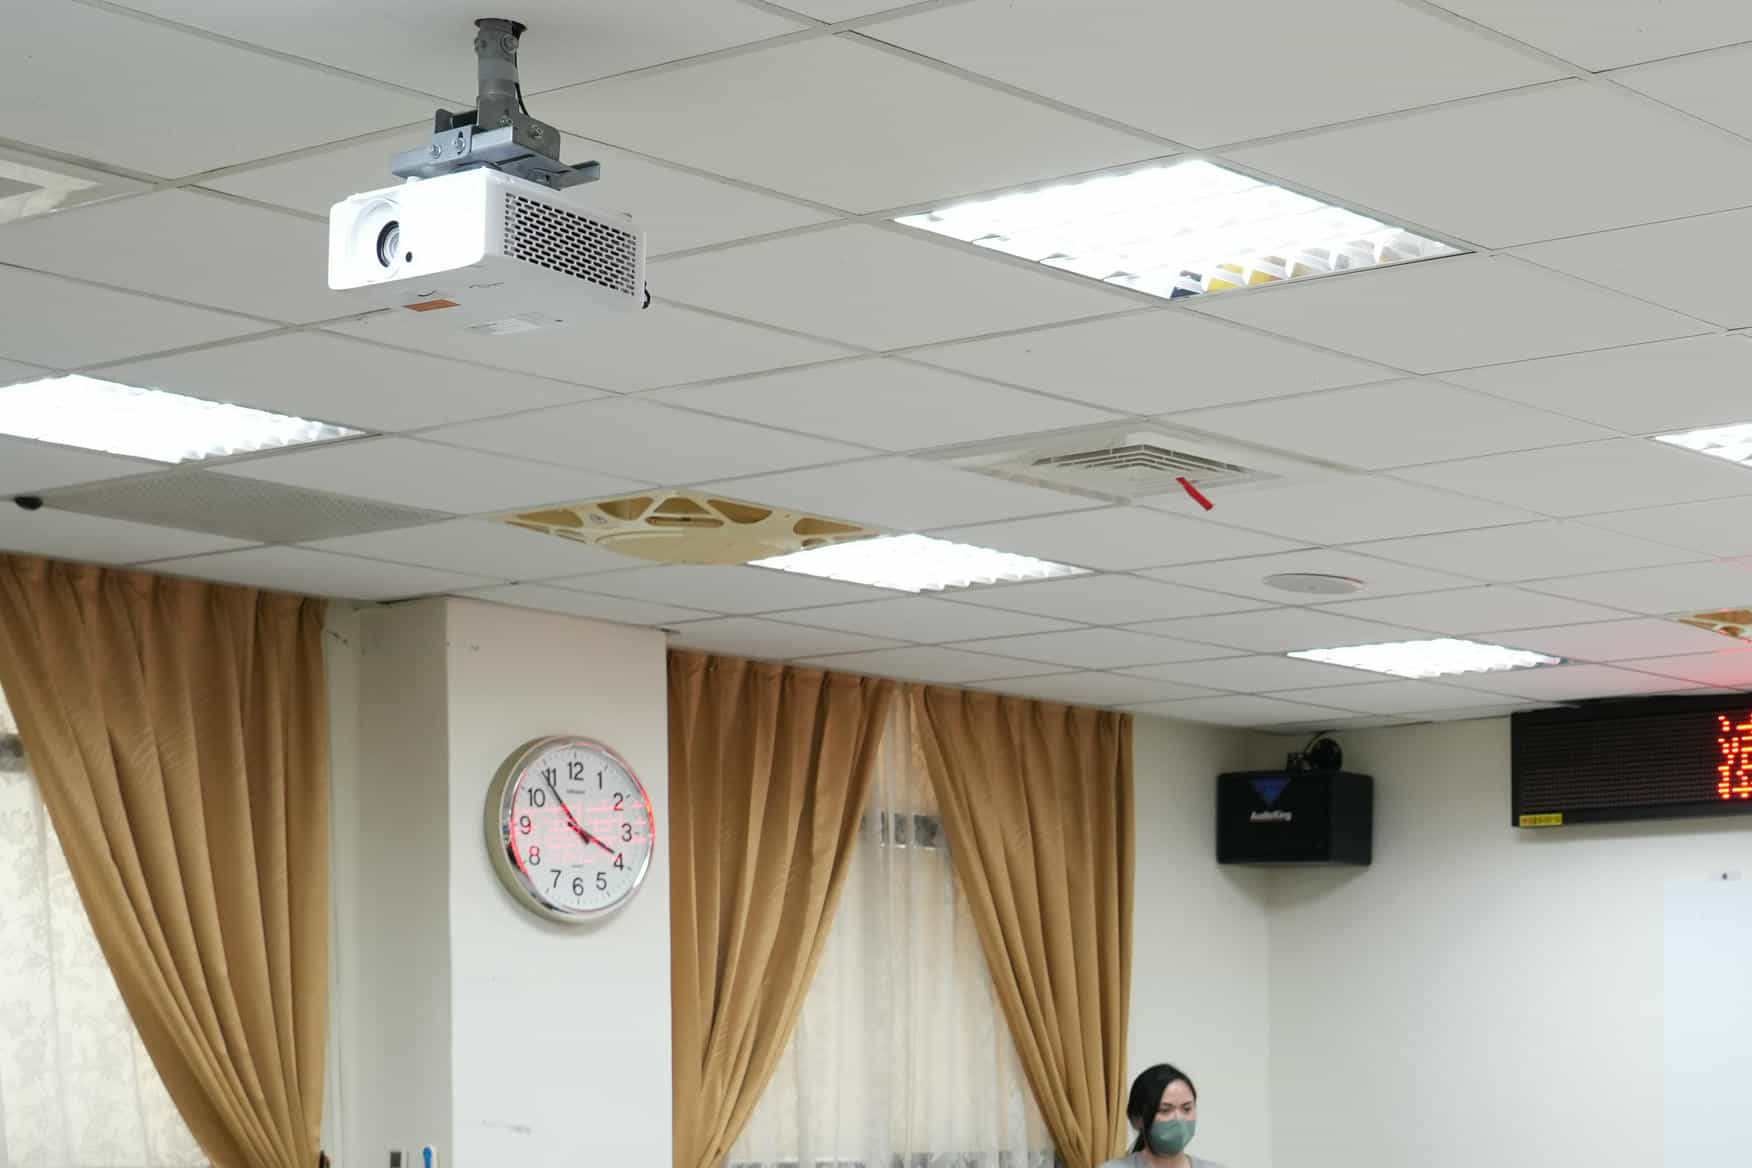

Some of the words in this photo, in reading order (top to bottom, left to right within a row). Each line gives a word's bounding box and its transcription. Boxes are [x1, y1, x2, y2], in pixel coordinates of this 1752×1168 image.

[568, 762, 584, 780] 12
[597, 772, 603, 789] 1
[528, 788, 545, 807] 10
[614, 793, 624, 811] 2
[520, 816, 531, 835] 9
[622, 824, 632, 841] 3
[529, 846, 540, 865] 8
[614, 853, 624, 871] 4
[551, 870, 561, 888] 7
[573, 878, 584, 896] 6
[596, 872, 607, 890] 5
